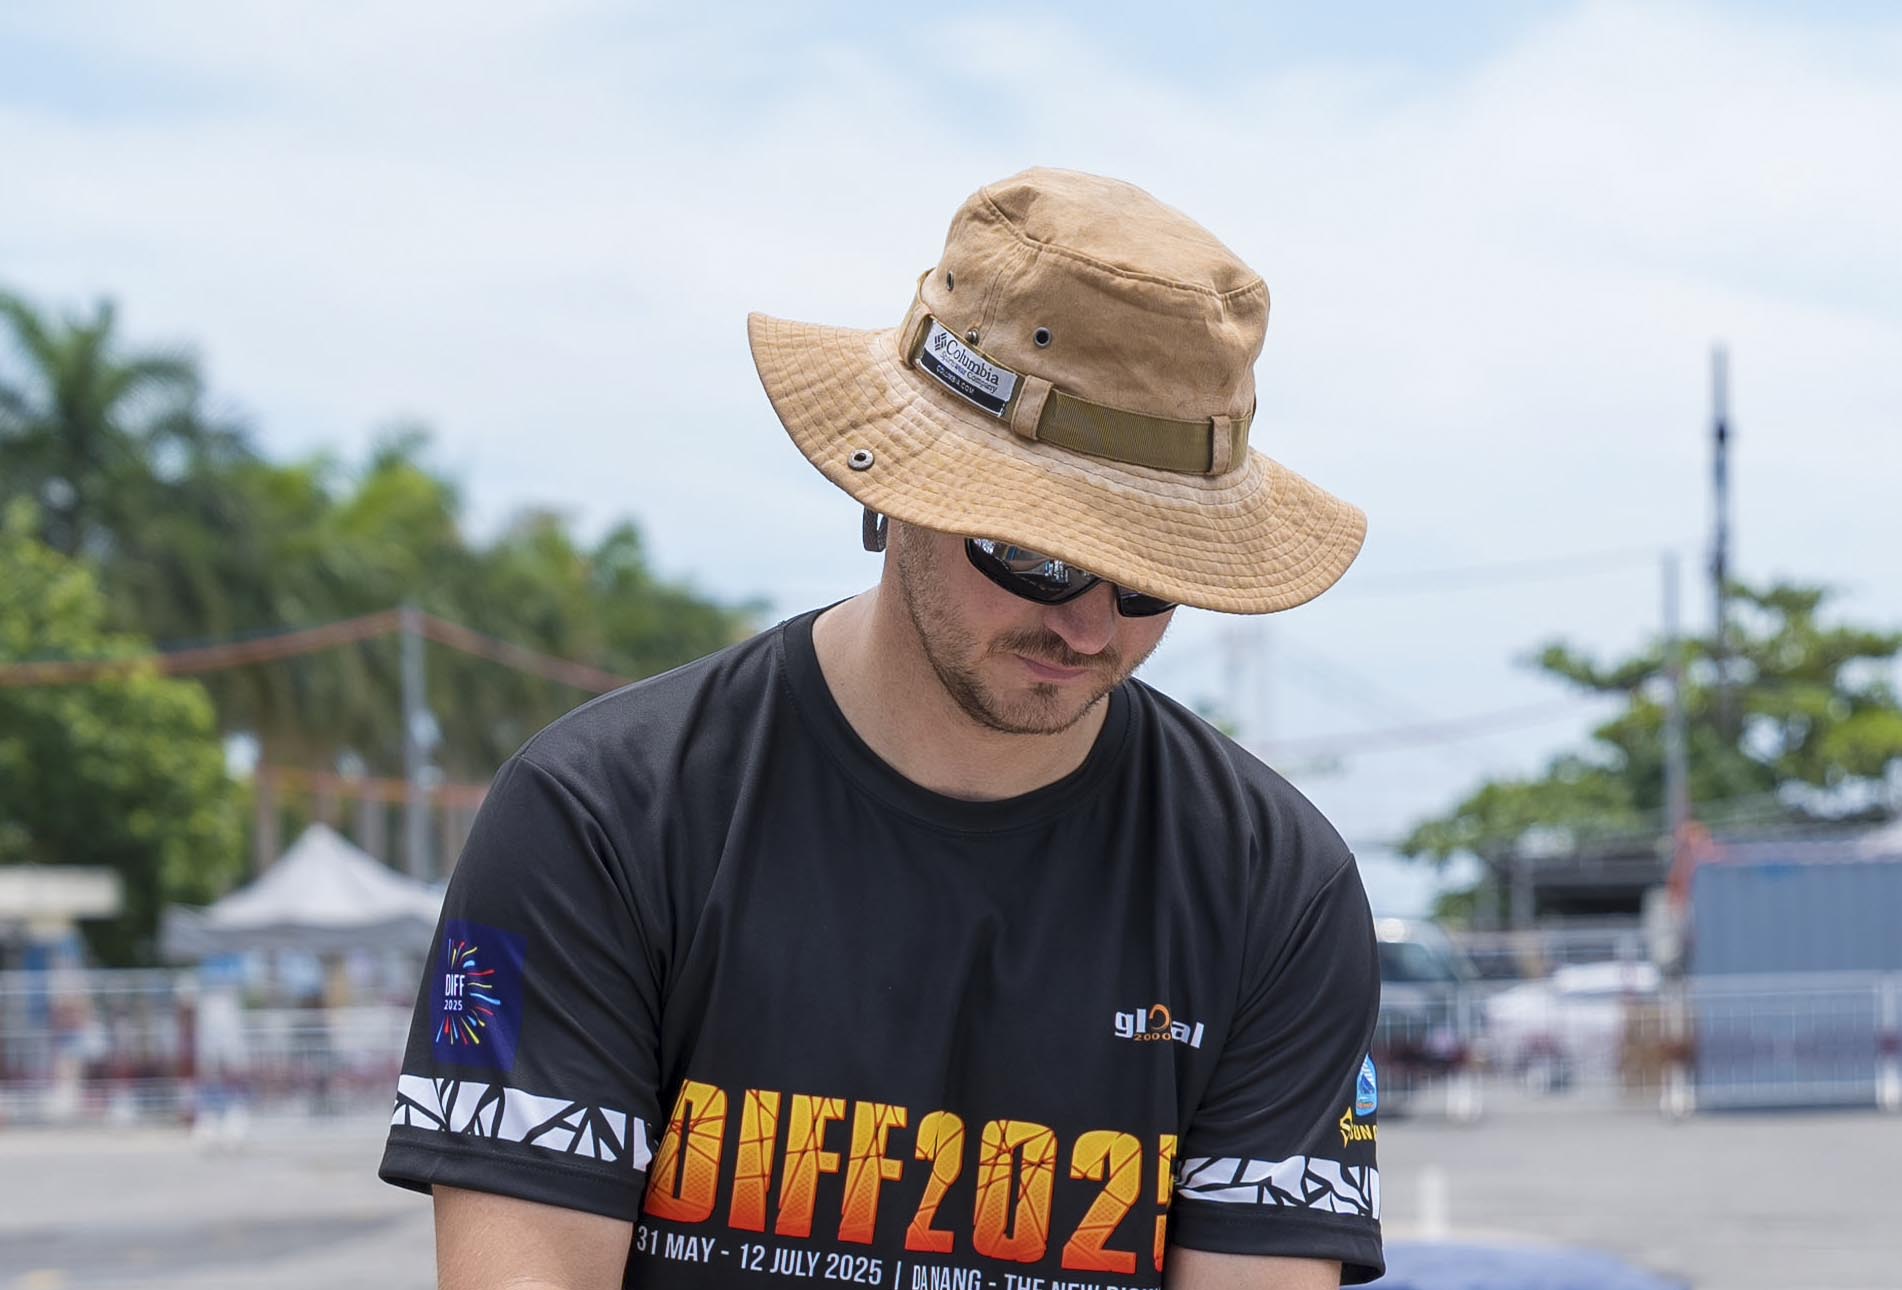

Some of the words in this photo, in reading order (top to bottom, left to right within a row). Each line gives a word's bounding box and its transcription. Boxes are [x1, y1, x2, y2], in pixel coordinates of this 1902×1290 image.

[946, 340, 999, 386] Columbia
[445, 974, 465, 996] DIFF
[444, 1000, 462, 1011] 2025
[1134, 1033, 1171, 1041] 2000
[637, 1226, 658, 1256] 31
[664, 1232, 716, 1264] MAY
[740, 1243, 765, 1272] 12
[769, 1247, 821, 1278] JULY
[825, 1253, 882, 1286] 2025
